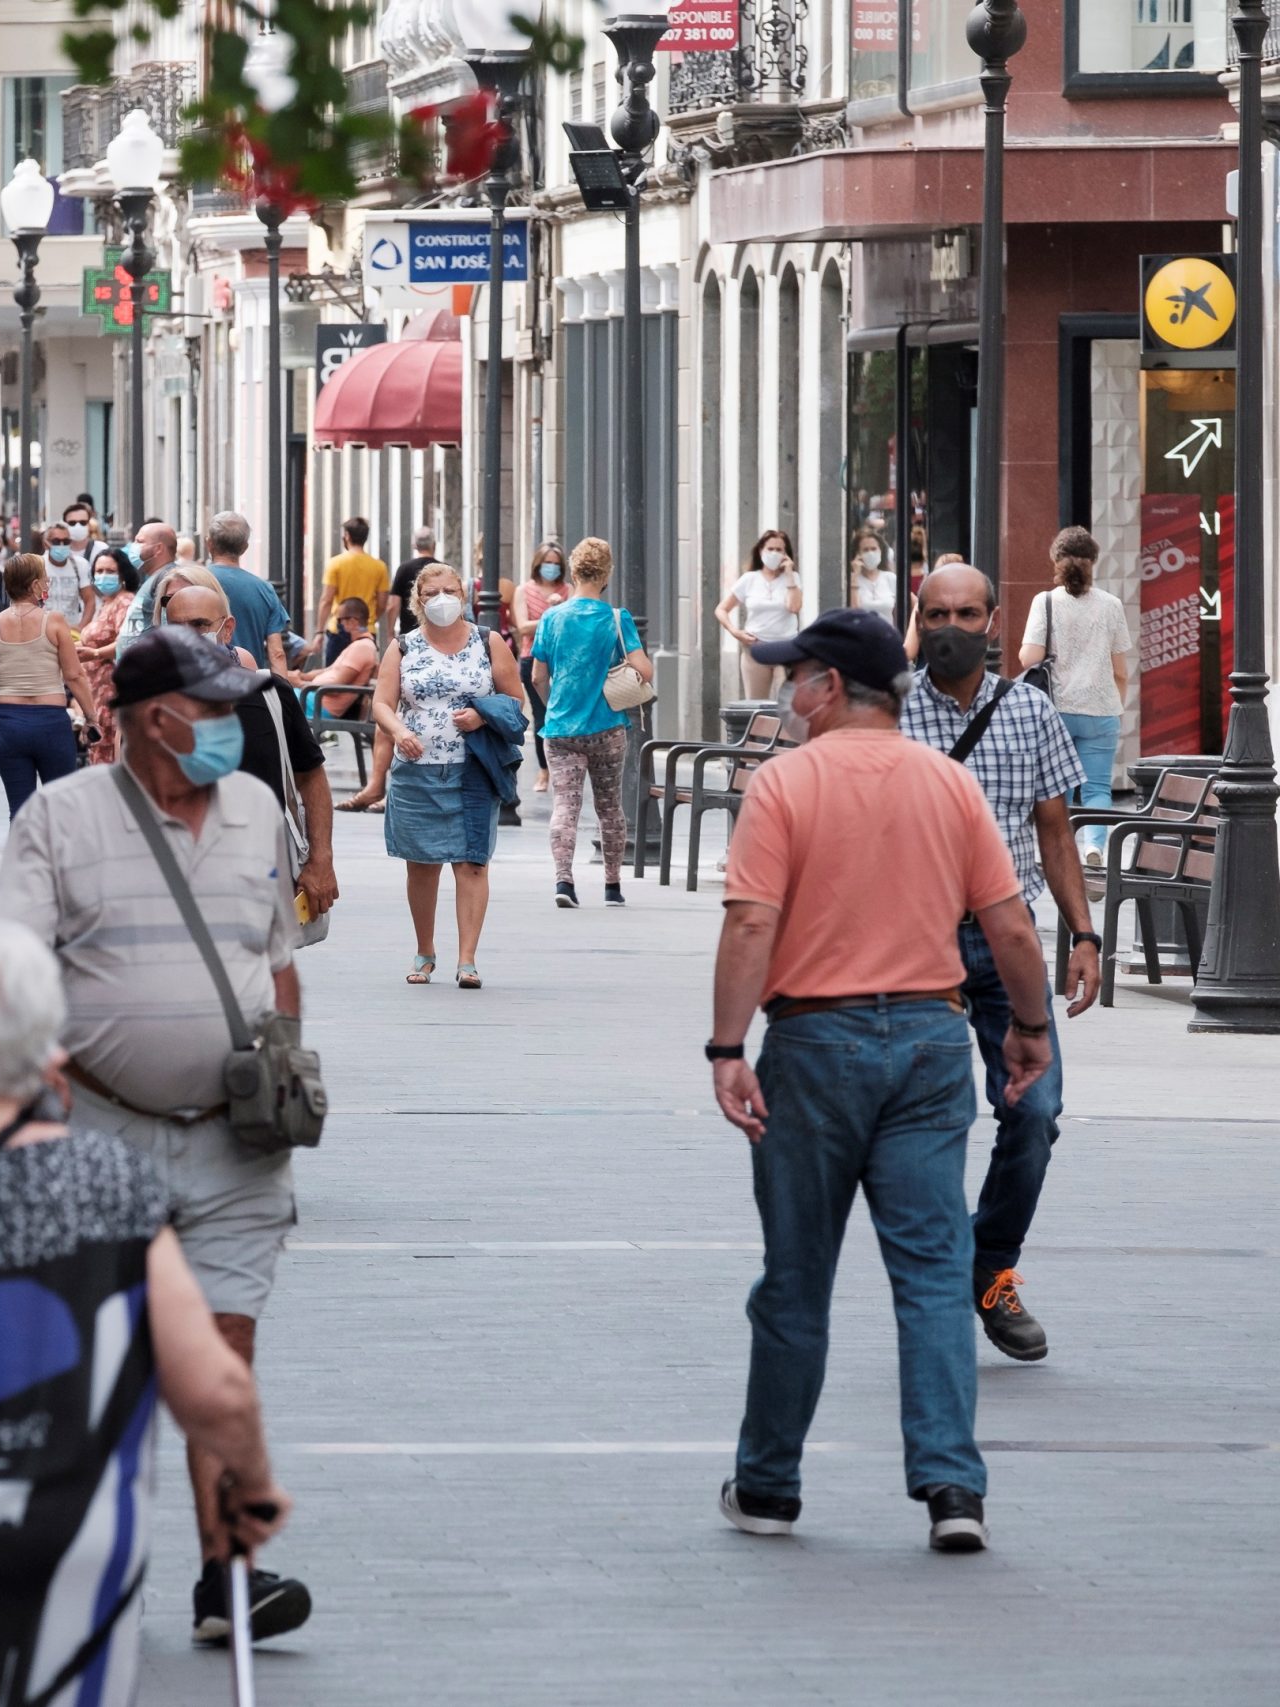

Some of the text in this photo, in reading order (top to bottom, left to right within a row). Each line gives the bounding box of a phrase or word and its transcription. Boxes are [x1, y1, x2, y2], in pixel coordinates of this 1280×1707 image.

[668, 10, 732, 24] ISPONIBLE
[683, 28, 708, 40] 381
[709, 27, 734, 40] 000
[415, 234, 521, 248] CONSTRUCTRA
[414, 255, 447, 270] SAN
[451, 252, 492, 271] JOSÉ,
[1141, 539, 1174, 556] ASTA
[1140, 593, 1200, 624] EBAJAS
[1140, 605, 1200, 636] EBAJAS
[1140, 617, 1200, 648] EBAJAS
[1140, 629, 1200, 660] EBAJAS
[1140, 642, 1200, 673] EBAJAS
